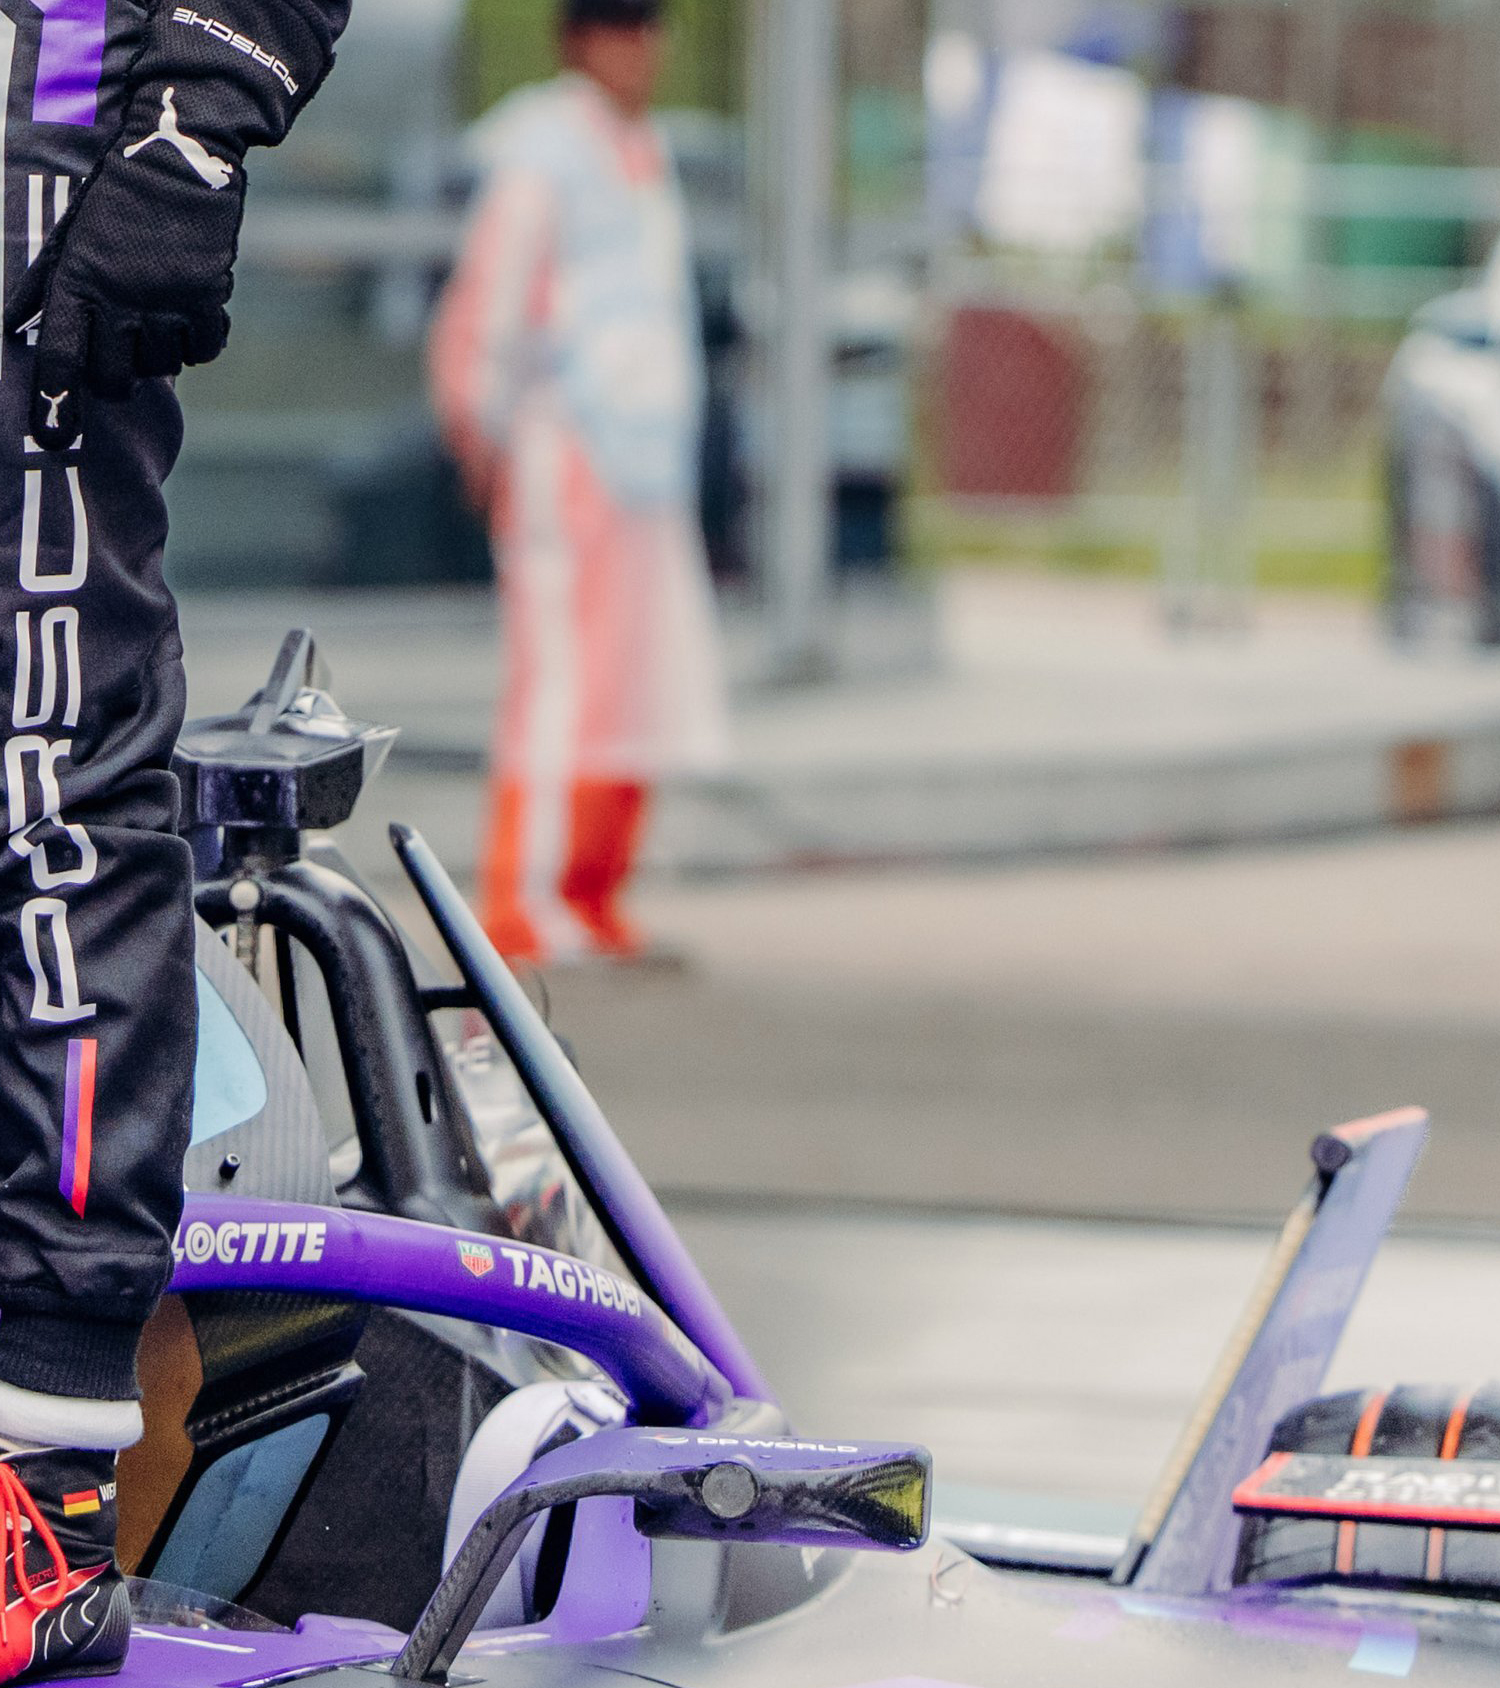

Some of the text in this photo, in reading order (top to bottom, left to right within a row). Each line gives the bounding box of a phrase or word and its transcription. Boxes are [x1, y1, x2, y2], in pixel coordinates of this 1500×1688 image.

[171, 6, 300, 96] PORSCHE
[696, 1436, 859, 1454] DP WORLD
